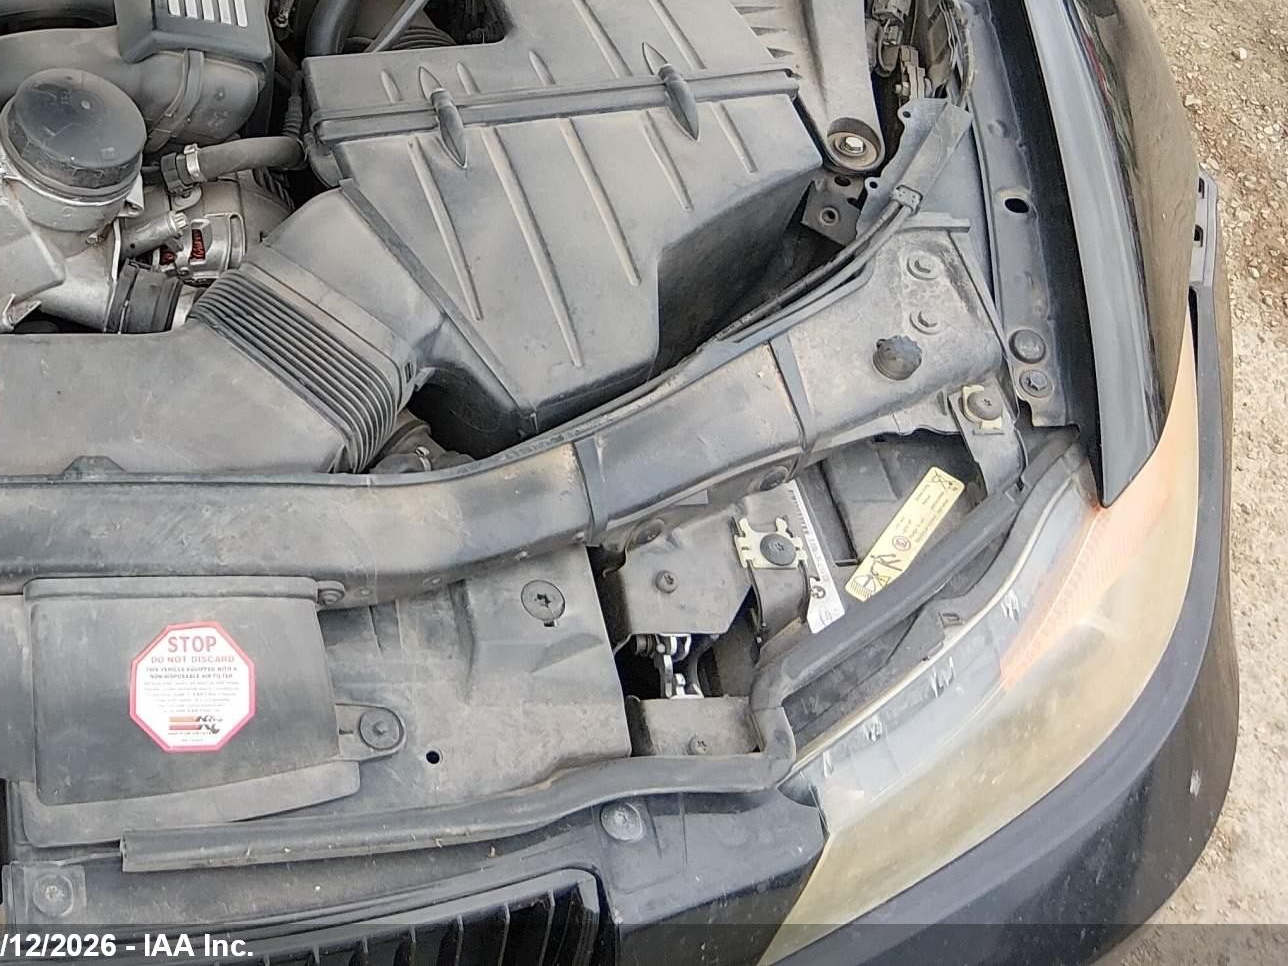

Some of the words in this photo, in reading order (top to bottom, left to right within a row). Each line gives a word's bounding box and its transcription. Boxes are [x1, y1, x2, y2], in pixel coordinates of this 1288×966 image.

[168, 636, 217, 653] STOP
[152, 656, 165, 664] DO
[168, 656, 187, 664] NOT
[191, 655, 235, 664] DISCARD
